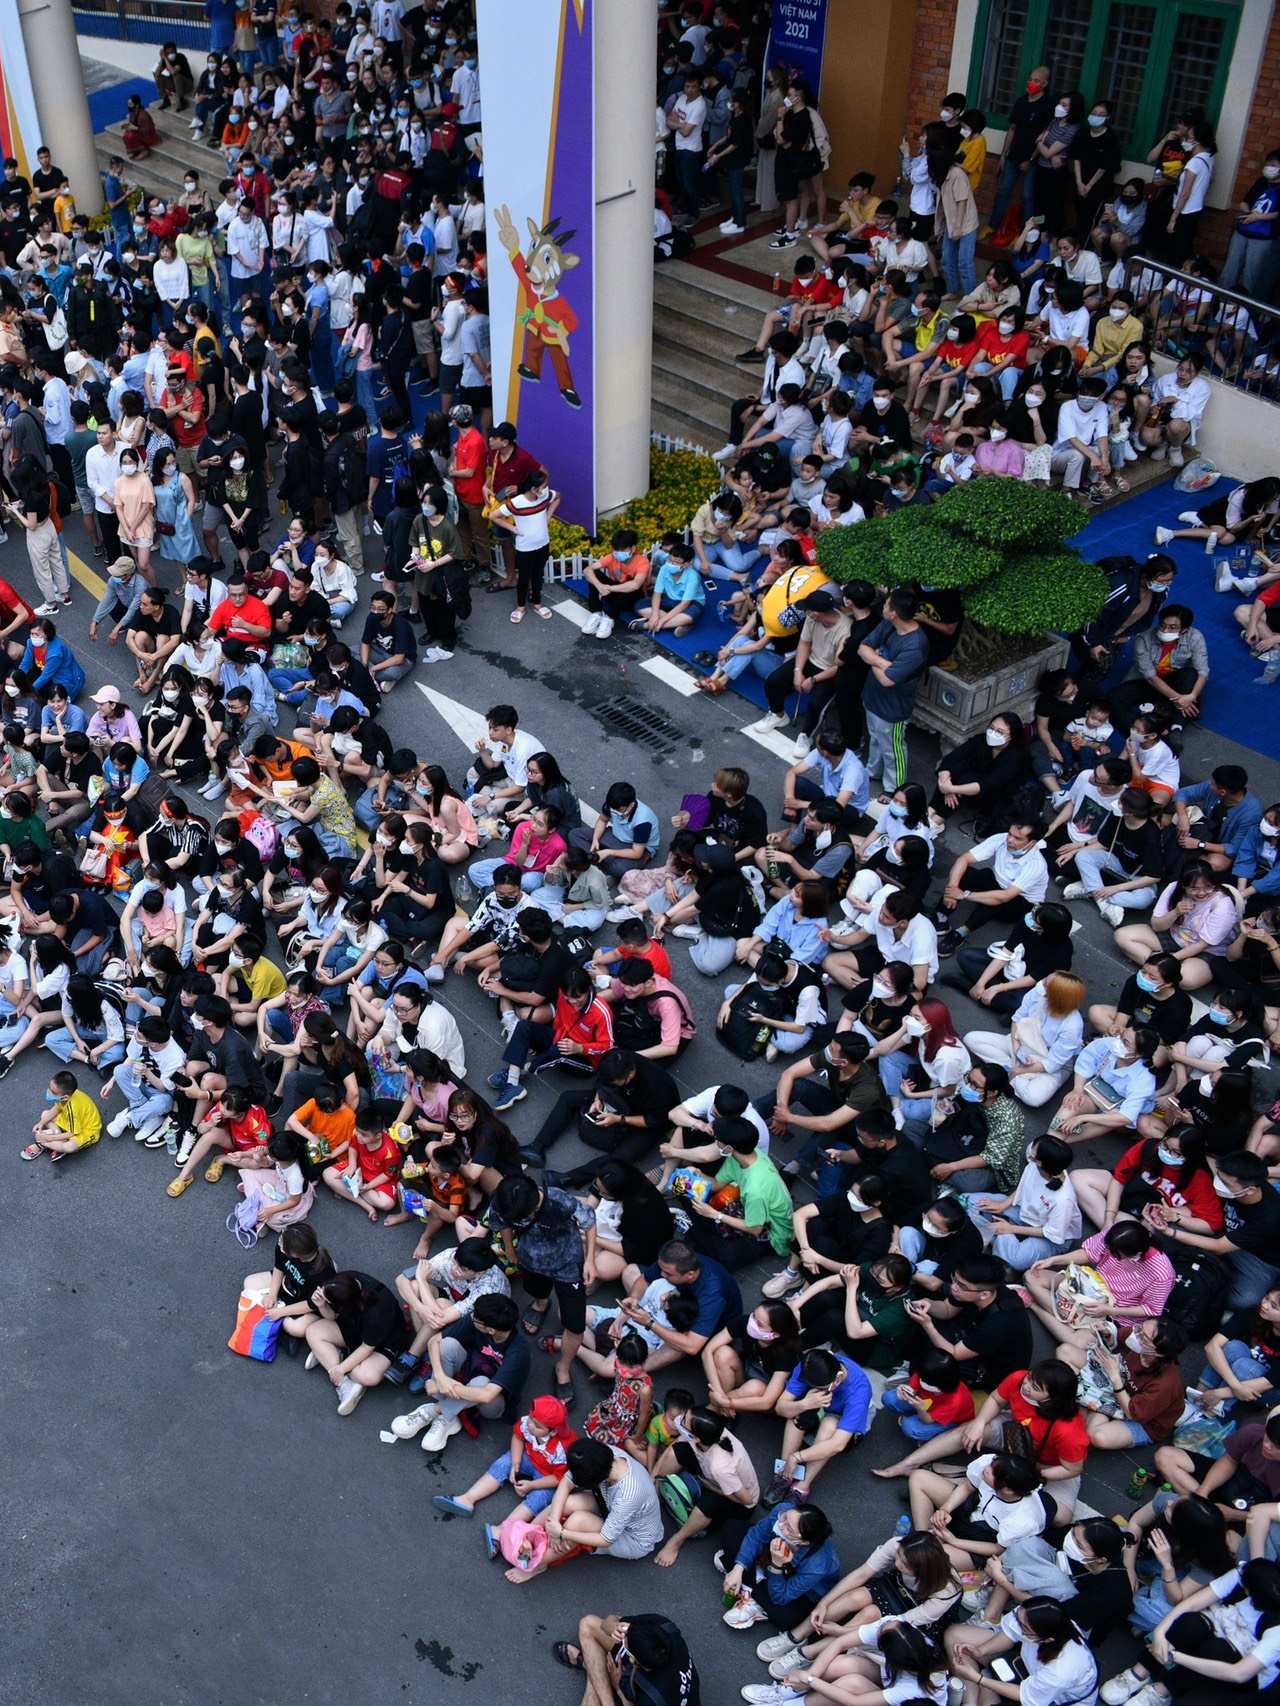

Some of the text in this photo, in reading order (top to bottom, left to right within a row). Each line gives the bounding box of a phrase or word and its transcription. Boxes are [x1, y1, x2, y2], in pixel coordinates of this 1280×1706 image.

[780, 3, 817, 21] VIỆT NAM
[785, 20, 809, 39] 2021
